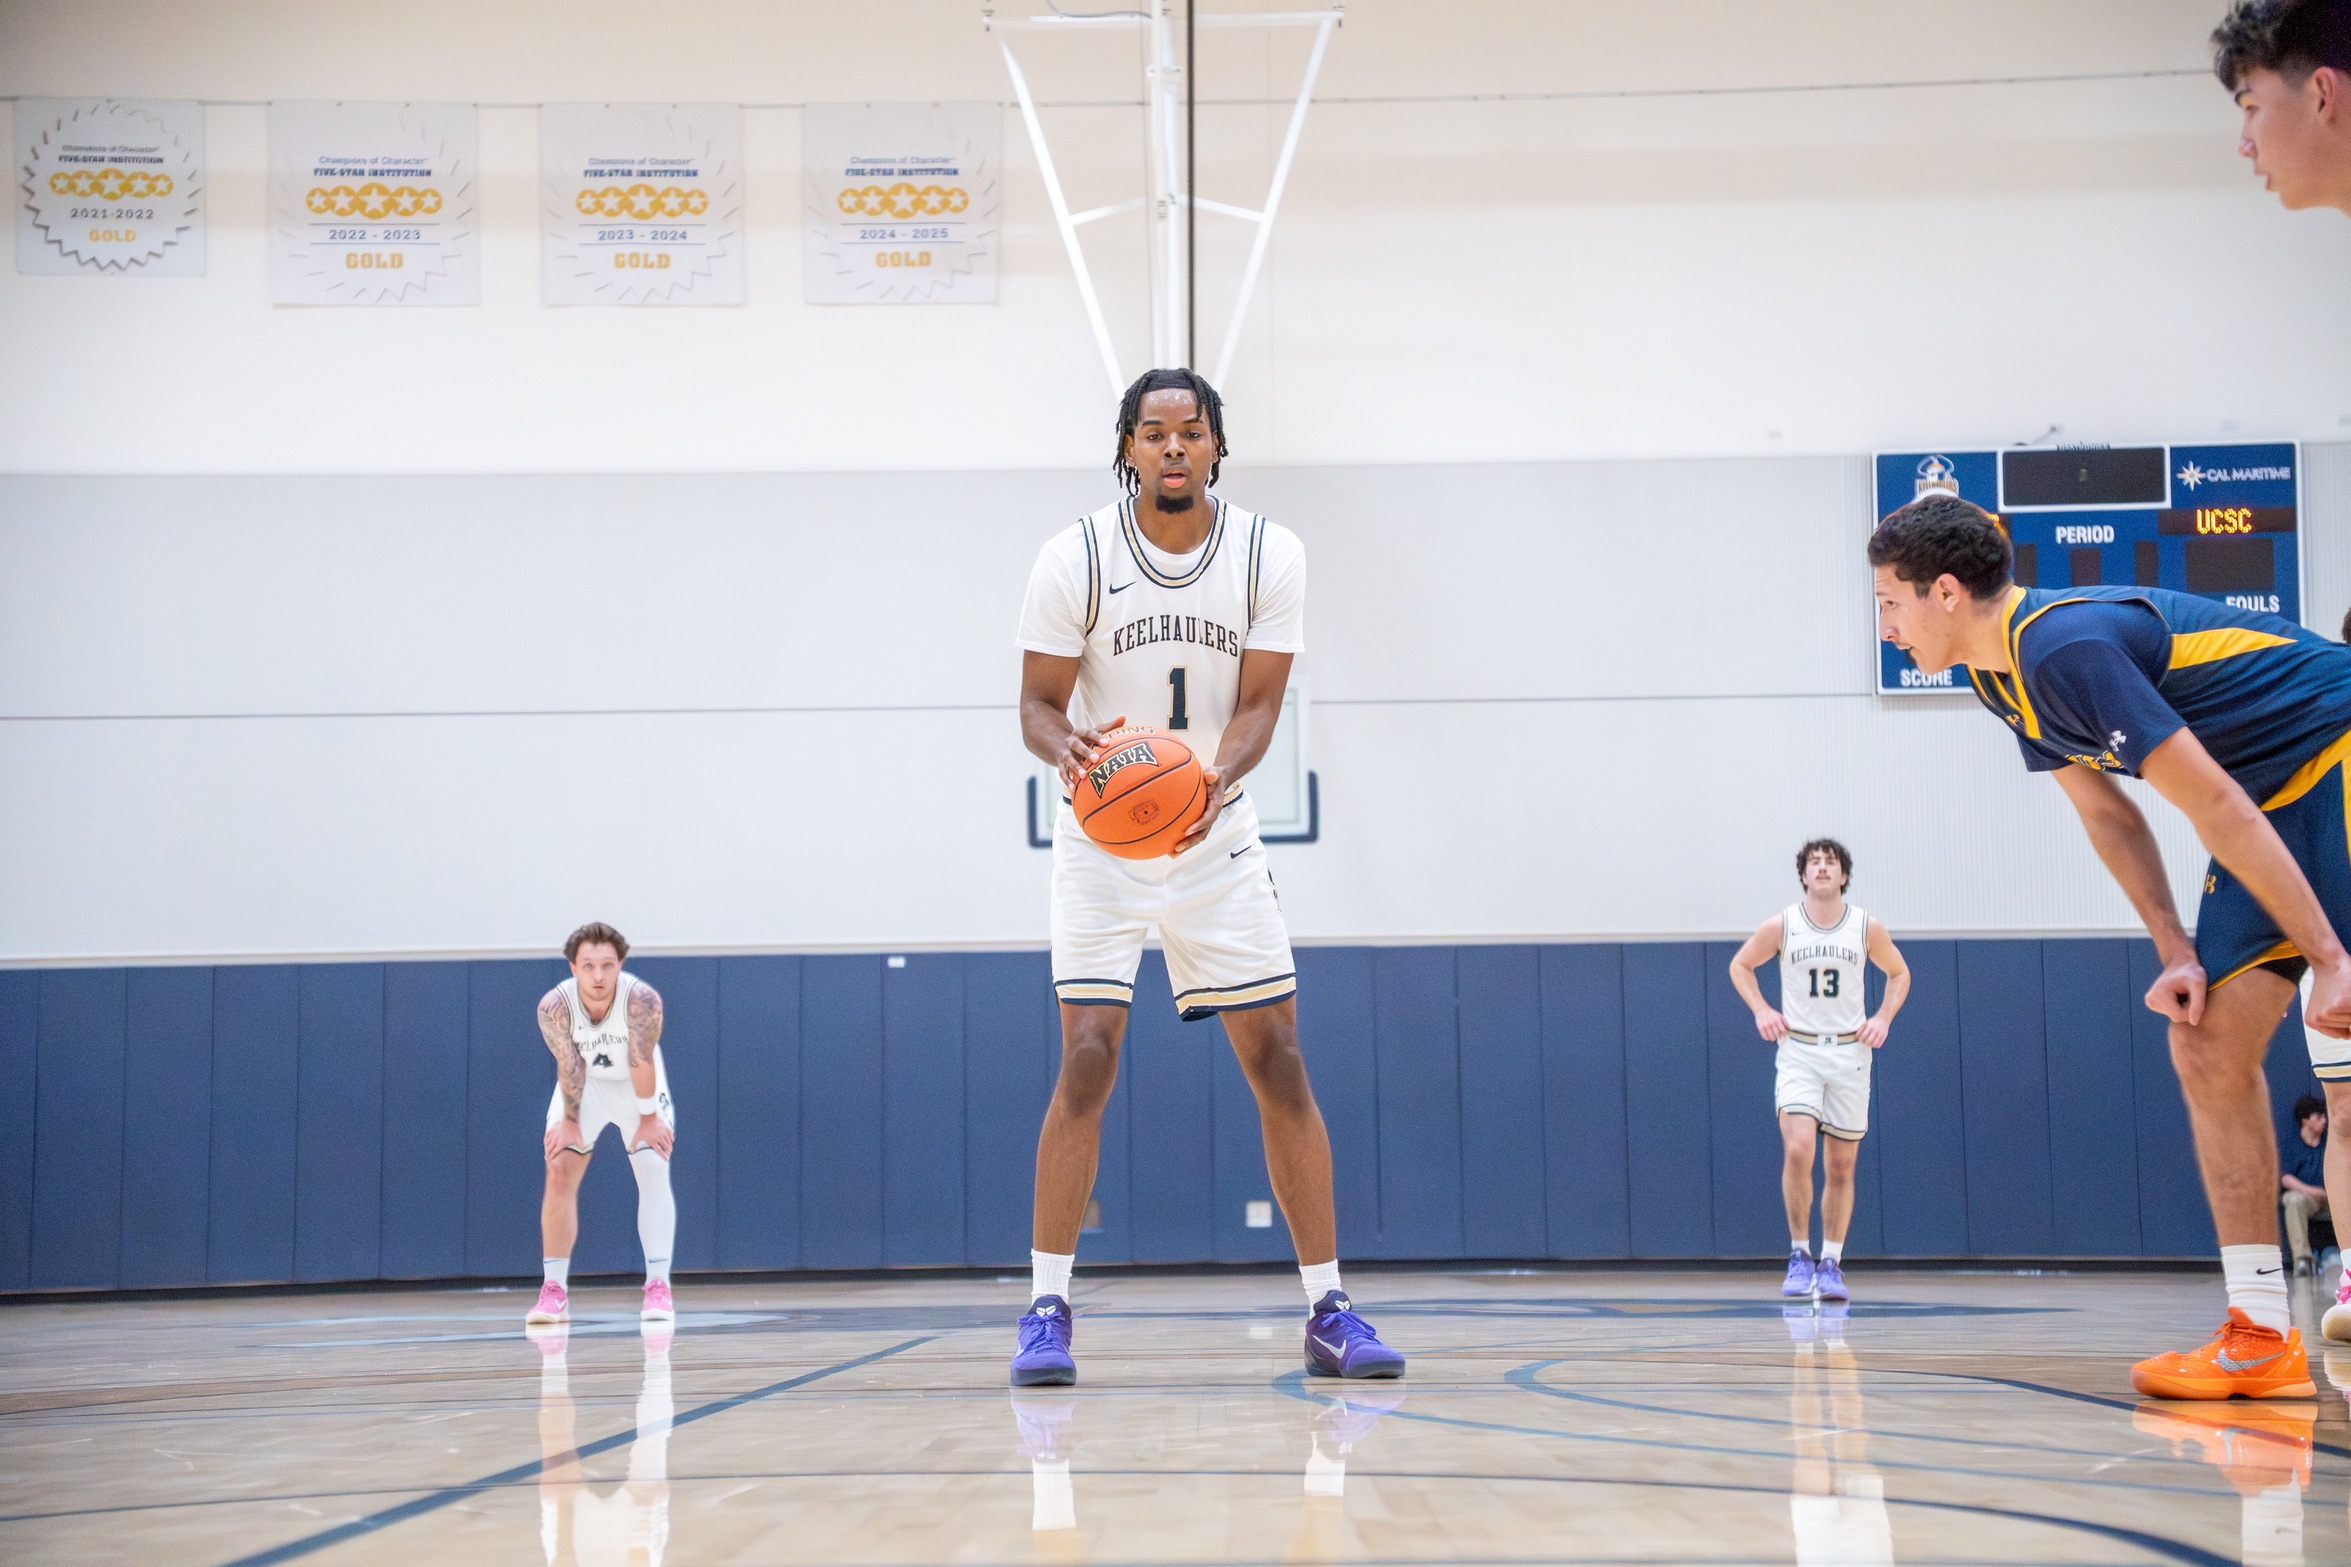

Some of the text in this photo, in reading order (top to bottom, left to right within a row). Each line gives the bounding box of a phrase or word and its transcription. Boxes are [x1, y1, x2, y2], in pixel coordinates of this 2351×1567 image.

[367, 168, 432, 178] INSTITUTION
[89, 229, 137, 242] GOLD
[329, 229, 367, 240] 2022
[383, 229, 421, 240] 2023
[598, 229, 635, 241] 2023
[650, 230, 688, 241] 2024
[860, 228, 897, 240] 2024
[912, 227, 949, 239] 2025
[345, 252, 404, 270] GOLD
[614, 251, 671, 270] GOLD
[876, 251, 932, 269] GOLD
[2206, 466, 2292, 482] CAL MARITIME
[2196, 507, 2253, 535] UCSC
[2055, 524, 2115, 545] PERIOD
[1900, 667, 1953, 687] SCORE
[1166, 665, 1190, 732] 1
[1088, 741, 1159, 799] NAIA
[1791, 944, 1859, 966] KEELHAULERS
[1809, 968, 1840, 998] 13
[592, 1053, 614, 1069] 4
